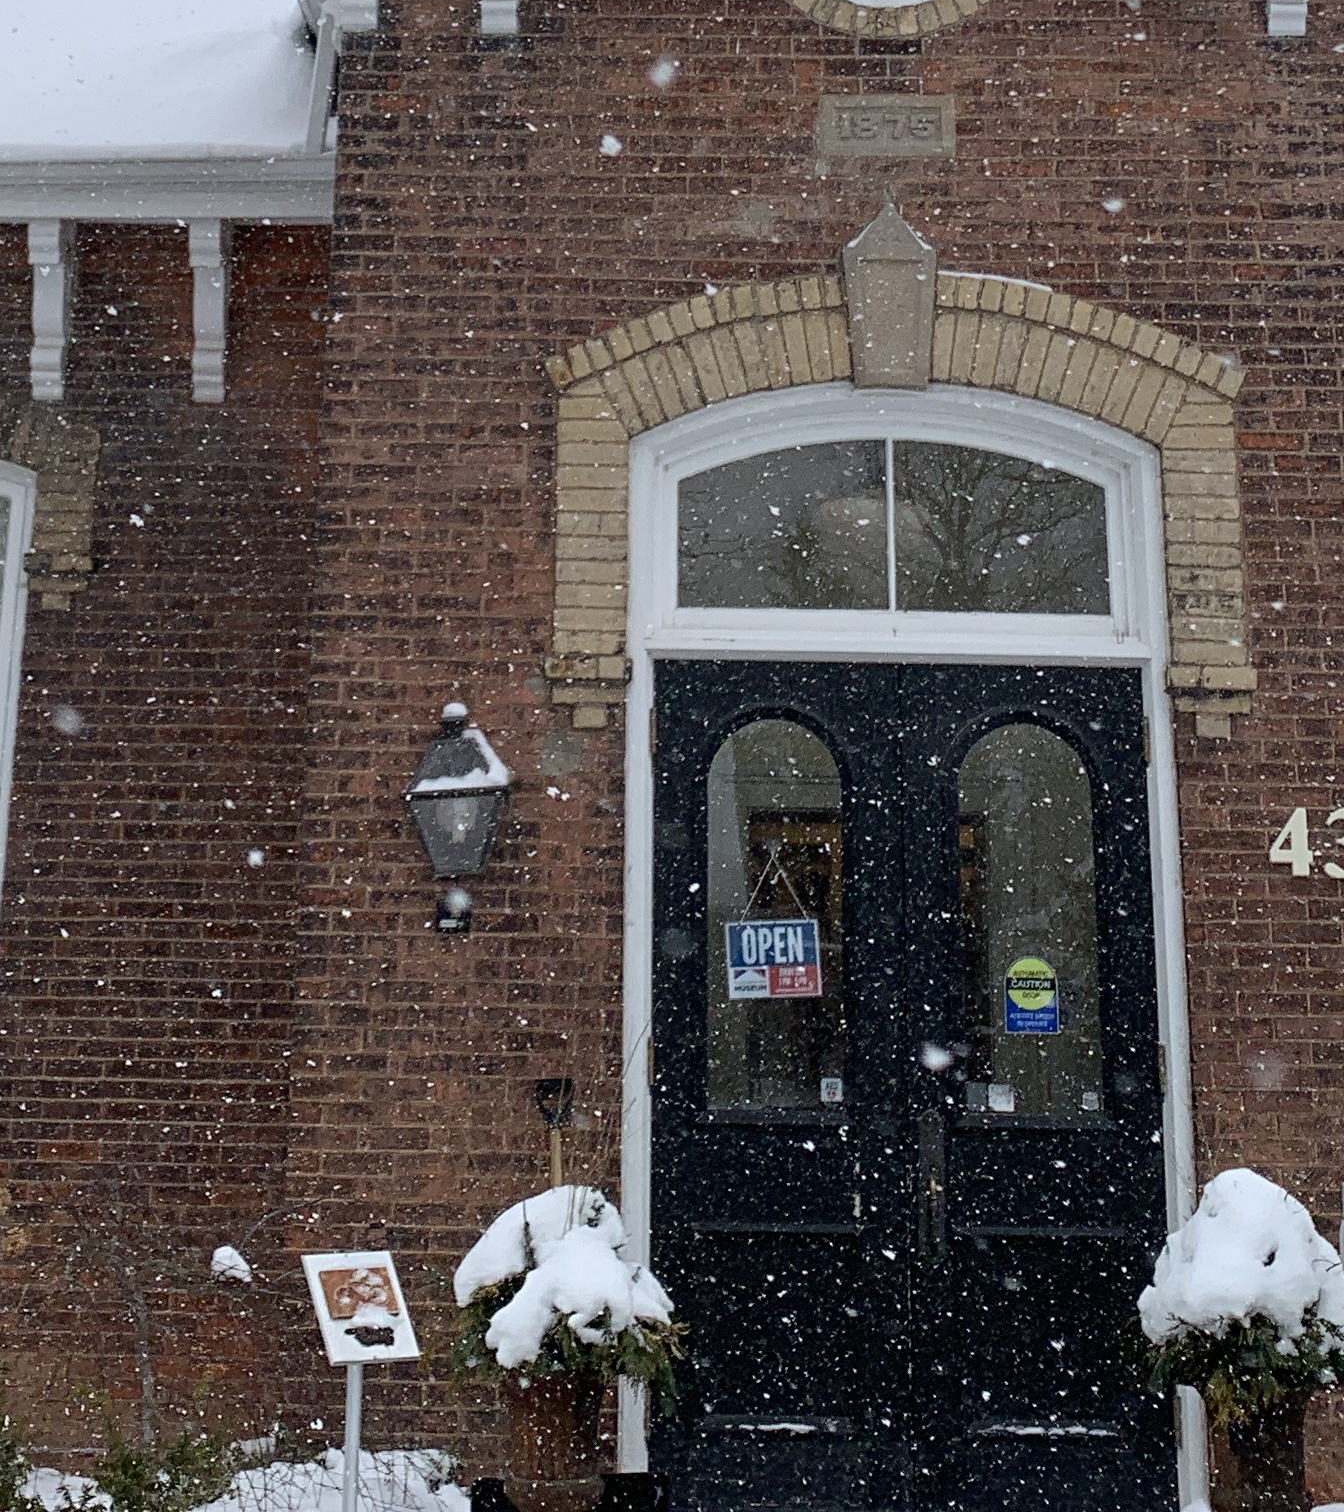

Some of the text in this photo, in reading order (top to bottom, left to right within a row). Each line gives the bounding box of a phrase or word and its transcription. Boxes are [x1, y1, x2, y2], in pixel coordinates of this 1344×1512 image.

[834, 112, 937, 139] 1875
[741, 925, 805, 965] OPEN
[734, 984, 767, 992] MUSEUM
[1010, 979, 1051, 989] CAUTION
